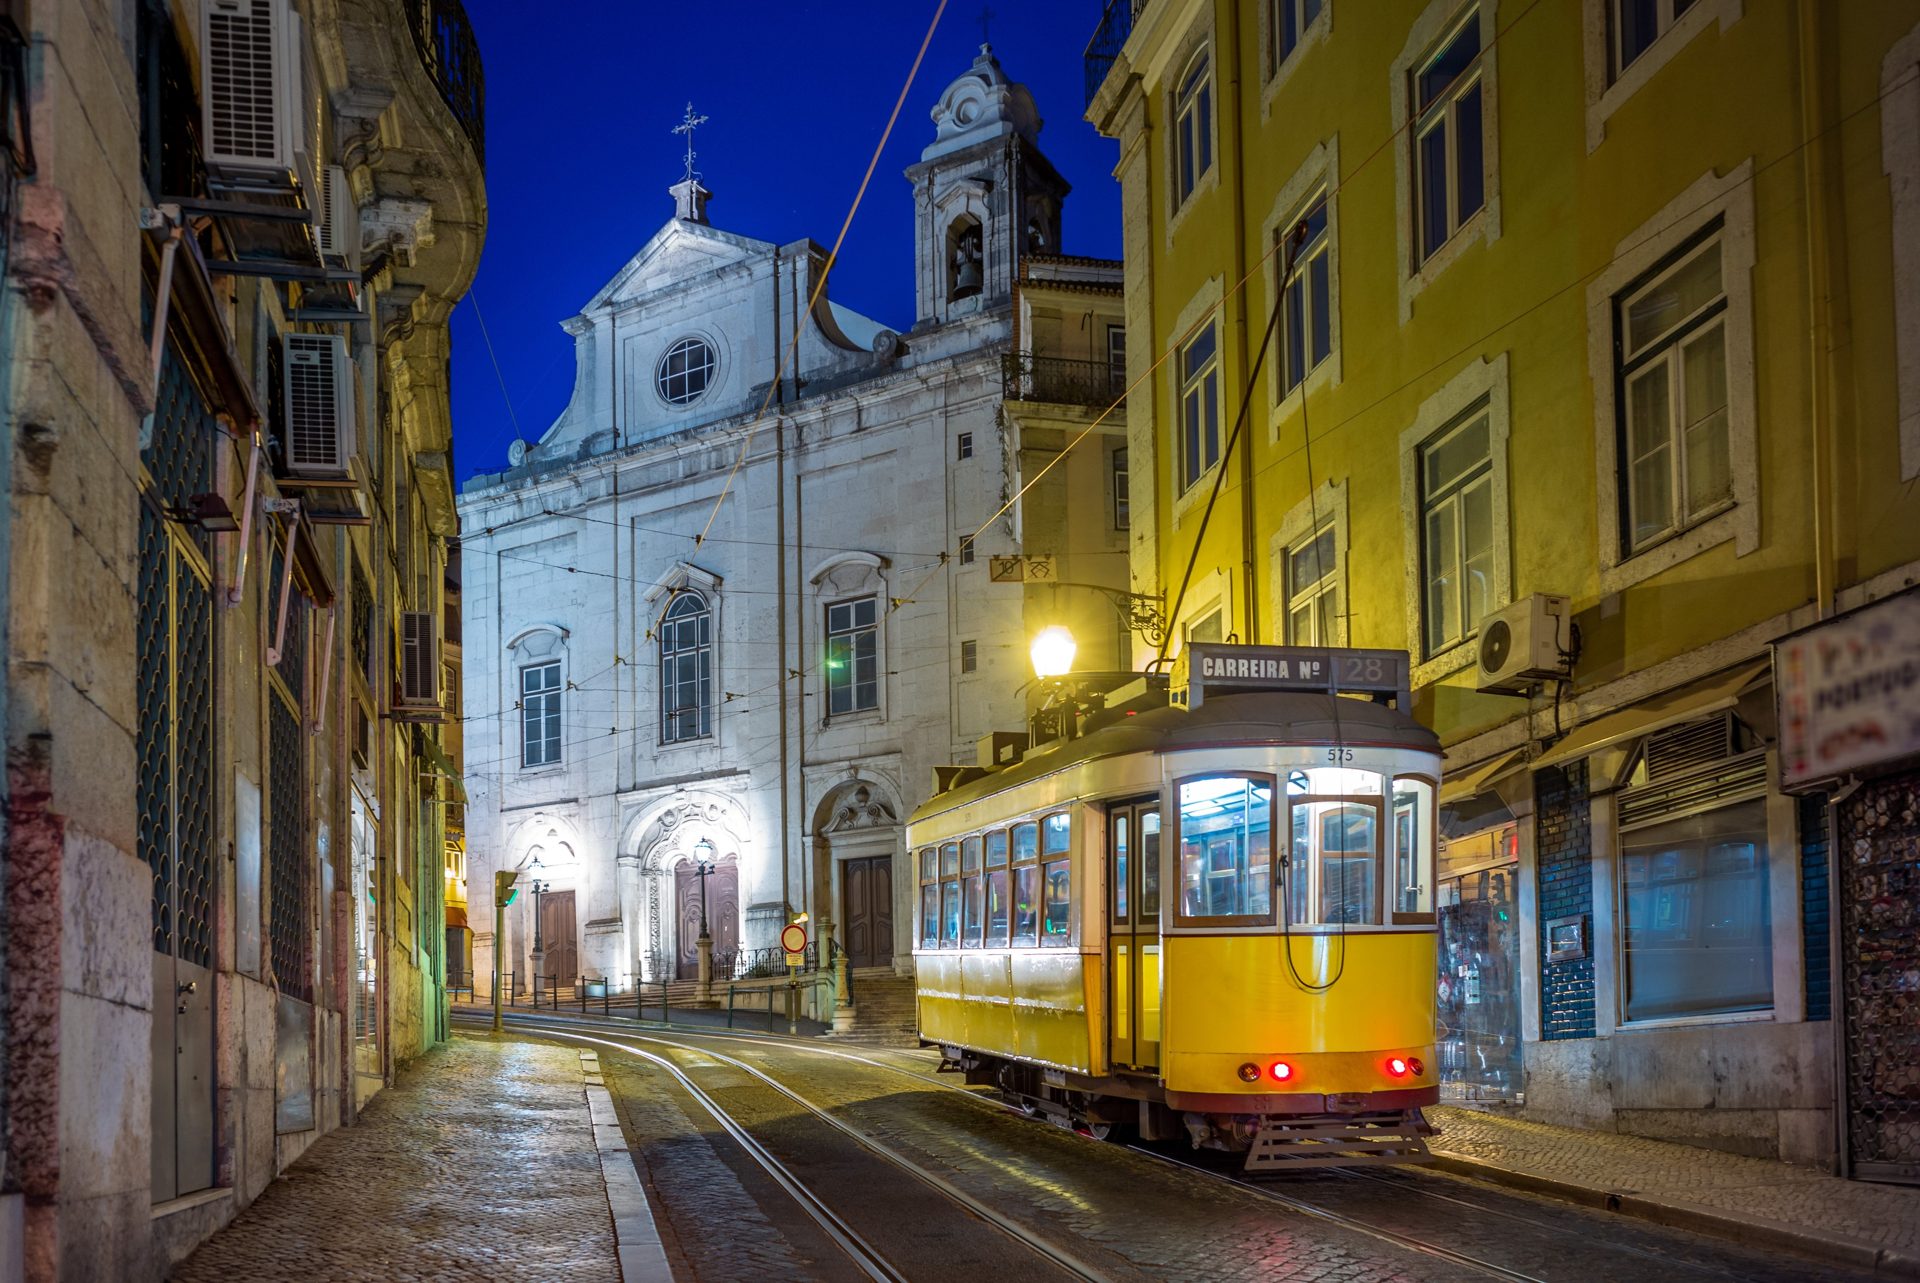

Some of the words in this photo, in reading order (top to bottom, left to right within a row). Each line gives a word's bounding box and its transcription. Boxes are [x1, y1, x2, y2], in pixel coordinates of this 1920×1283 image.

[1202, 657, 1290, 679] CARREIRA
[1346, 657, 1383, 682] 28
[1327, 748, 1354, 762] 575
